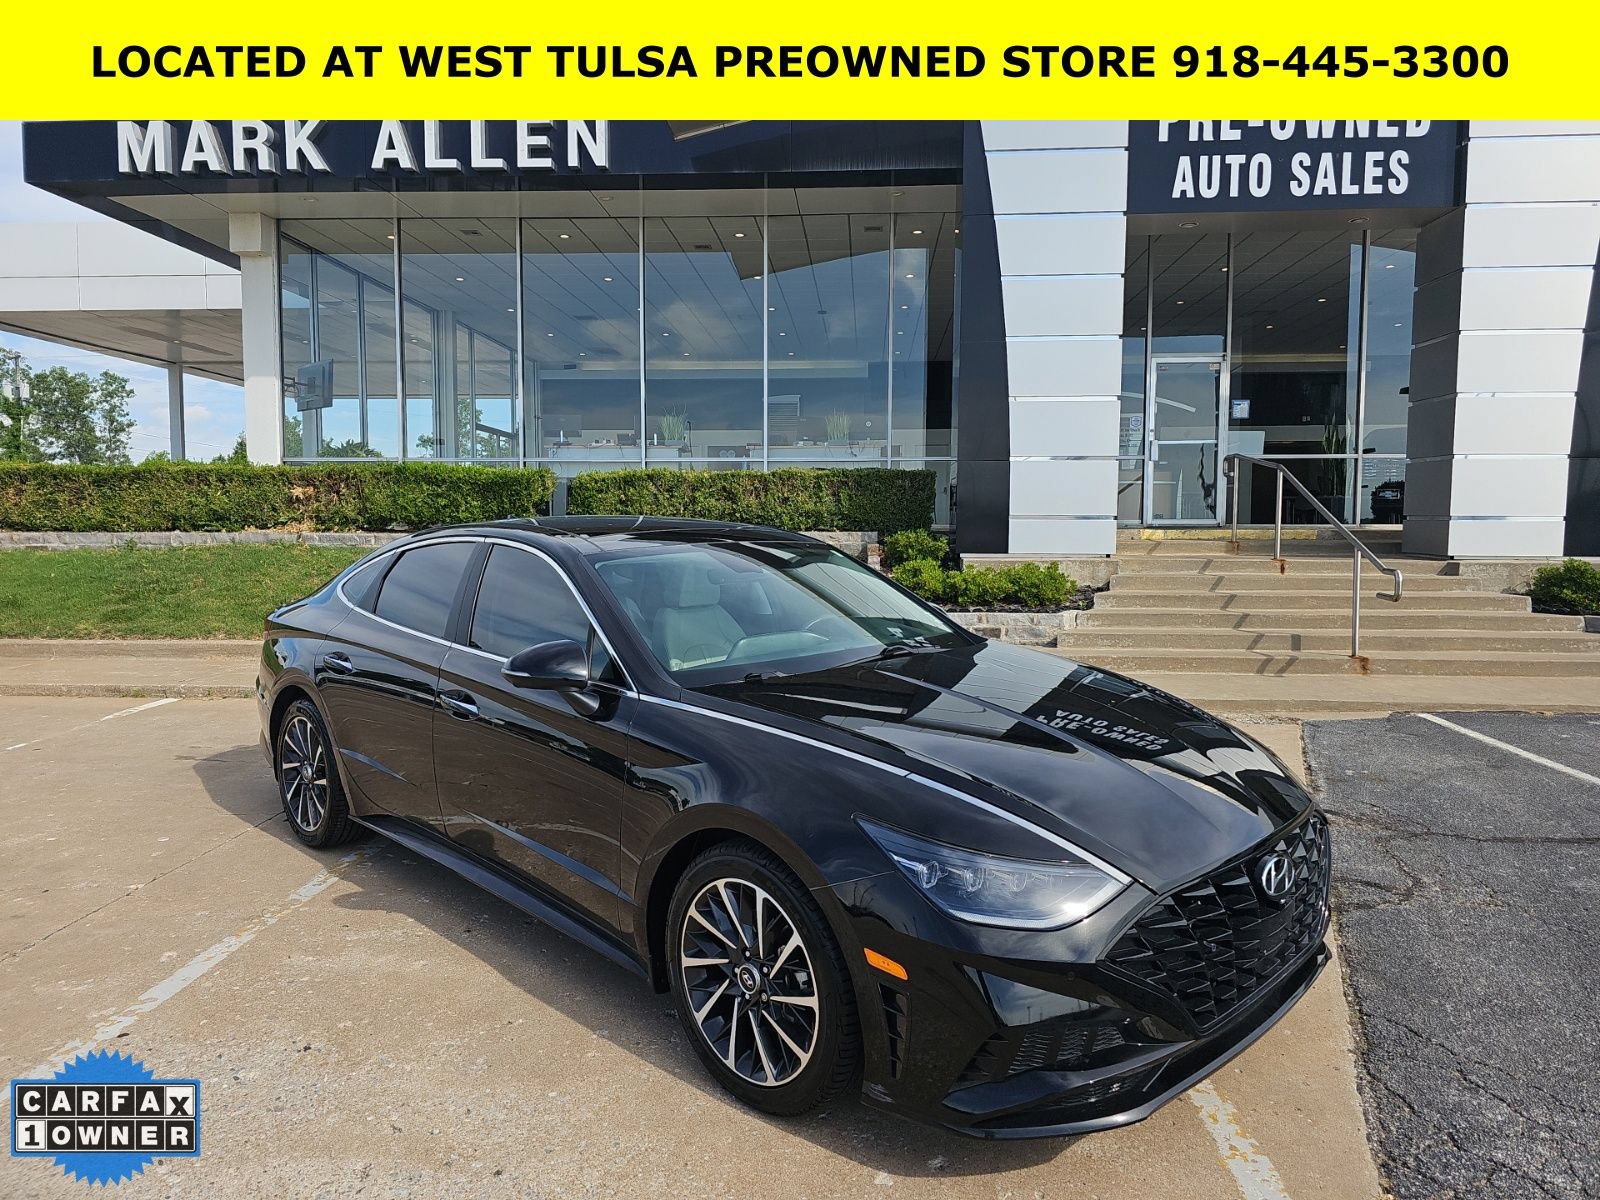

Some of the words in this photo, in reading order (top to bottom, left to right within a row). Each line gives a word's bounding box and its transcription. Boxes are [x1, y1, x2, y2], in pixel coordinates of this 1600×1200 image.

[117, 121, 333, 174] MARK
[371, 120, 610, 173] ALLEN
[1171, 153, 1272, 199] AUTO
[1289, 149, 1410, 198] SALES
